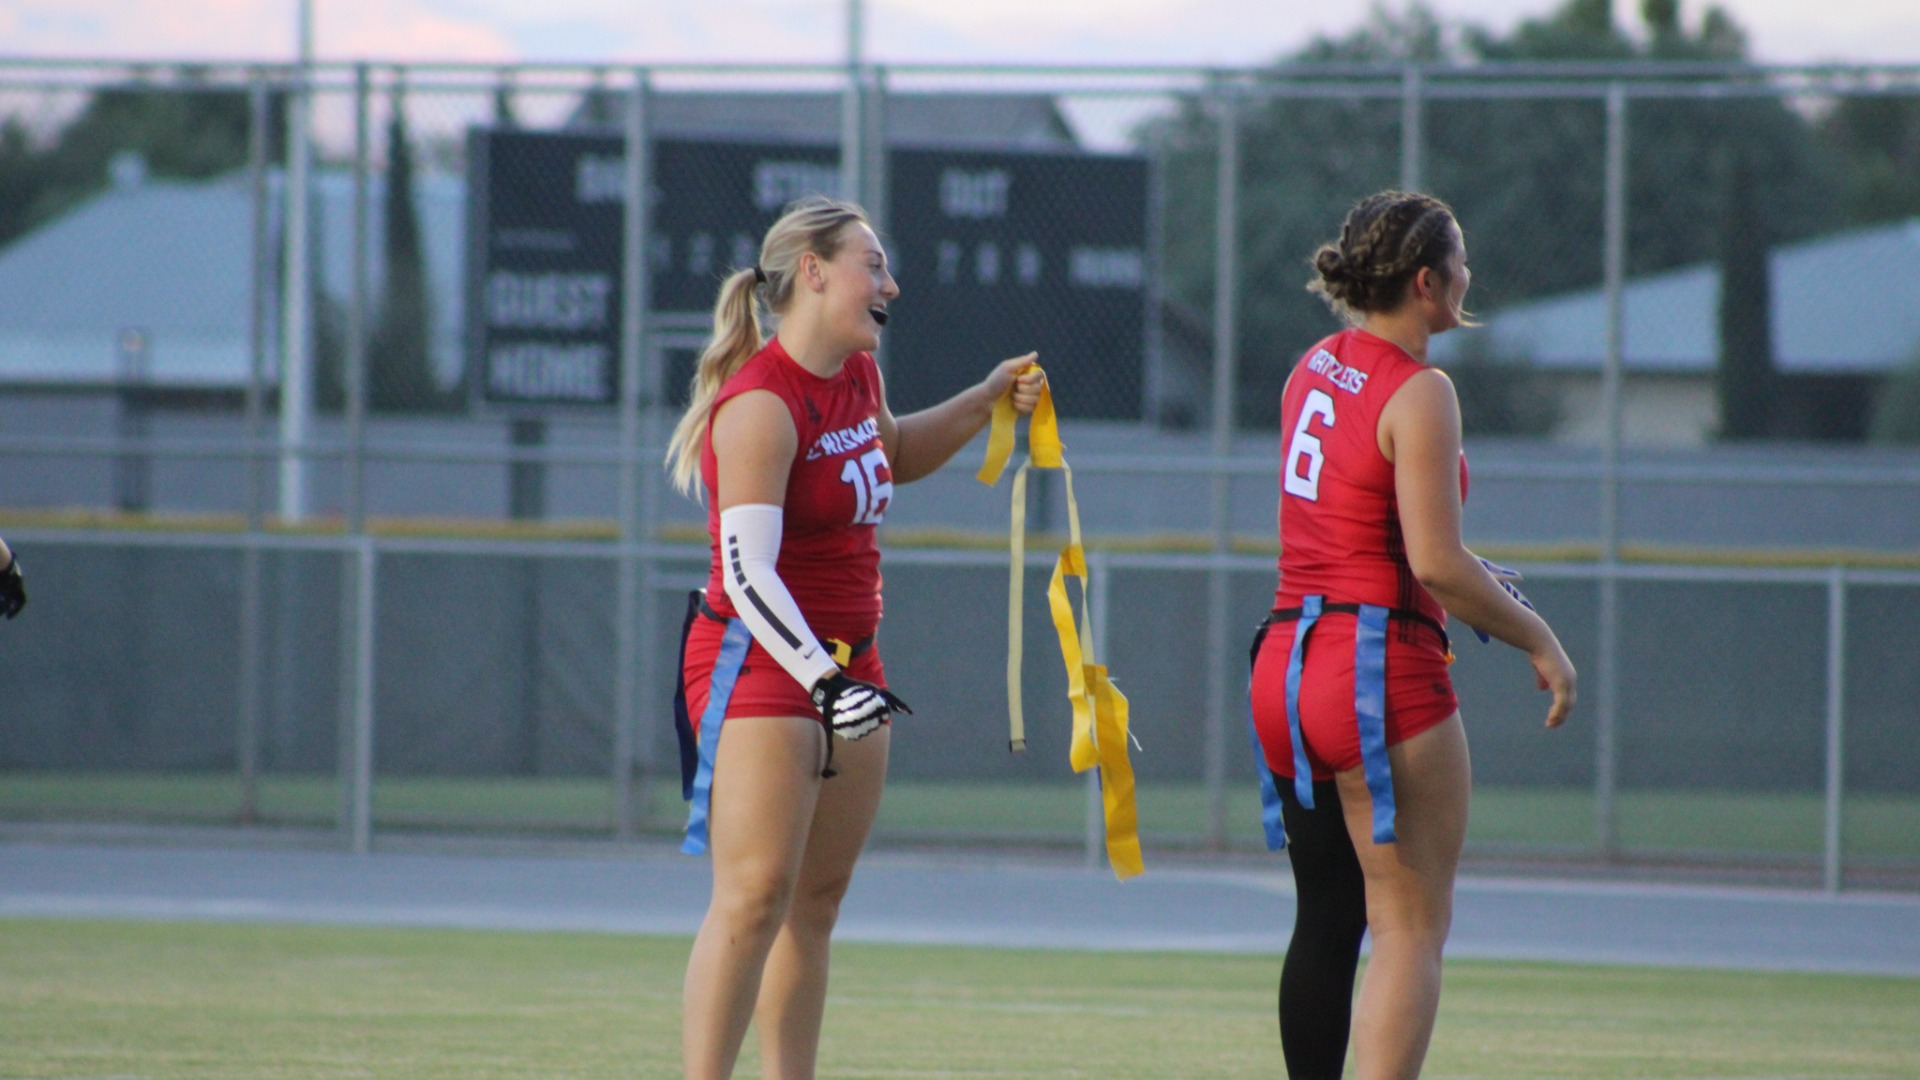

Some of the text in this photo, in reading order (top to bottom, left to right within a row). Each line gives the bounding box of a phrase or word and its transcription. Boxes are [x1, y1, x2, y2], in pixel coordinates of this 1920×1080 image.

[489, 272, 609, 328] GUEST
[489, 344, 608, 400] HOME
[1285, 388, 1336, 502] 6
[841, 448, 893, 524] 16
